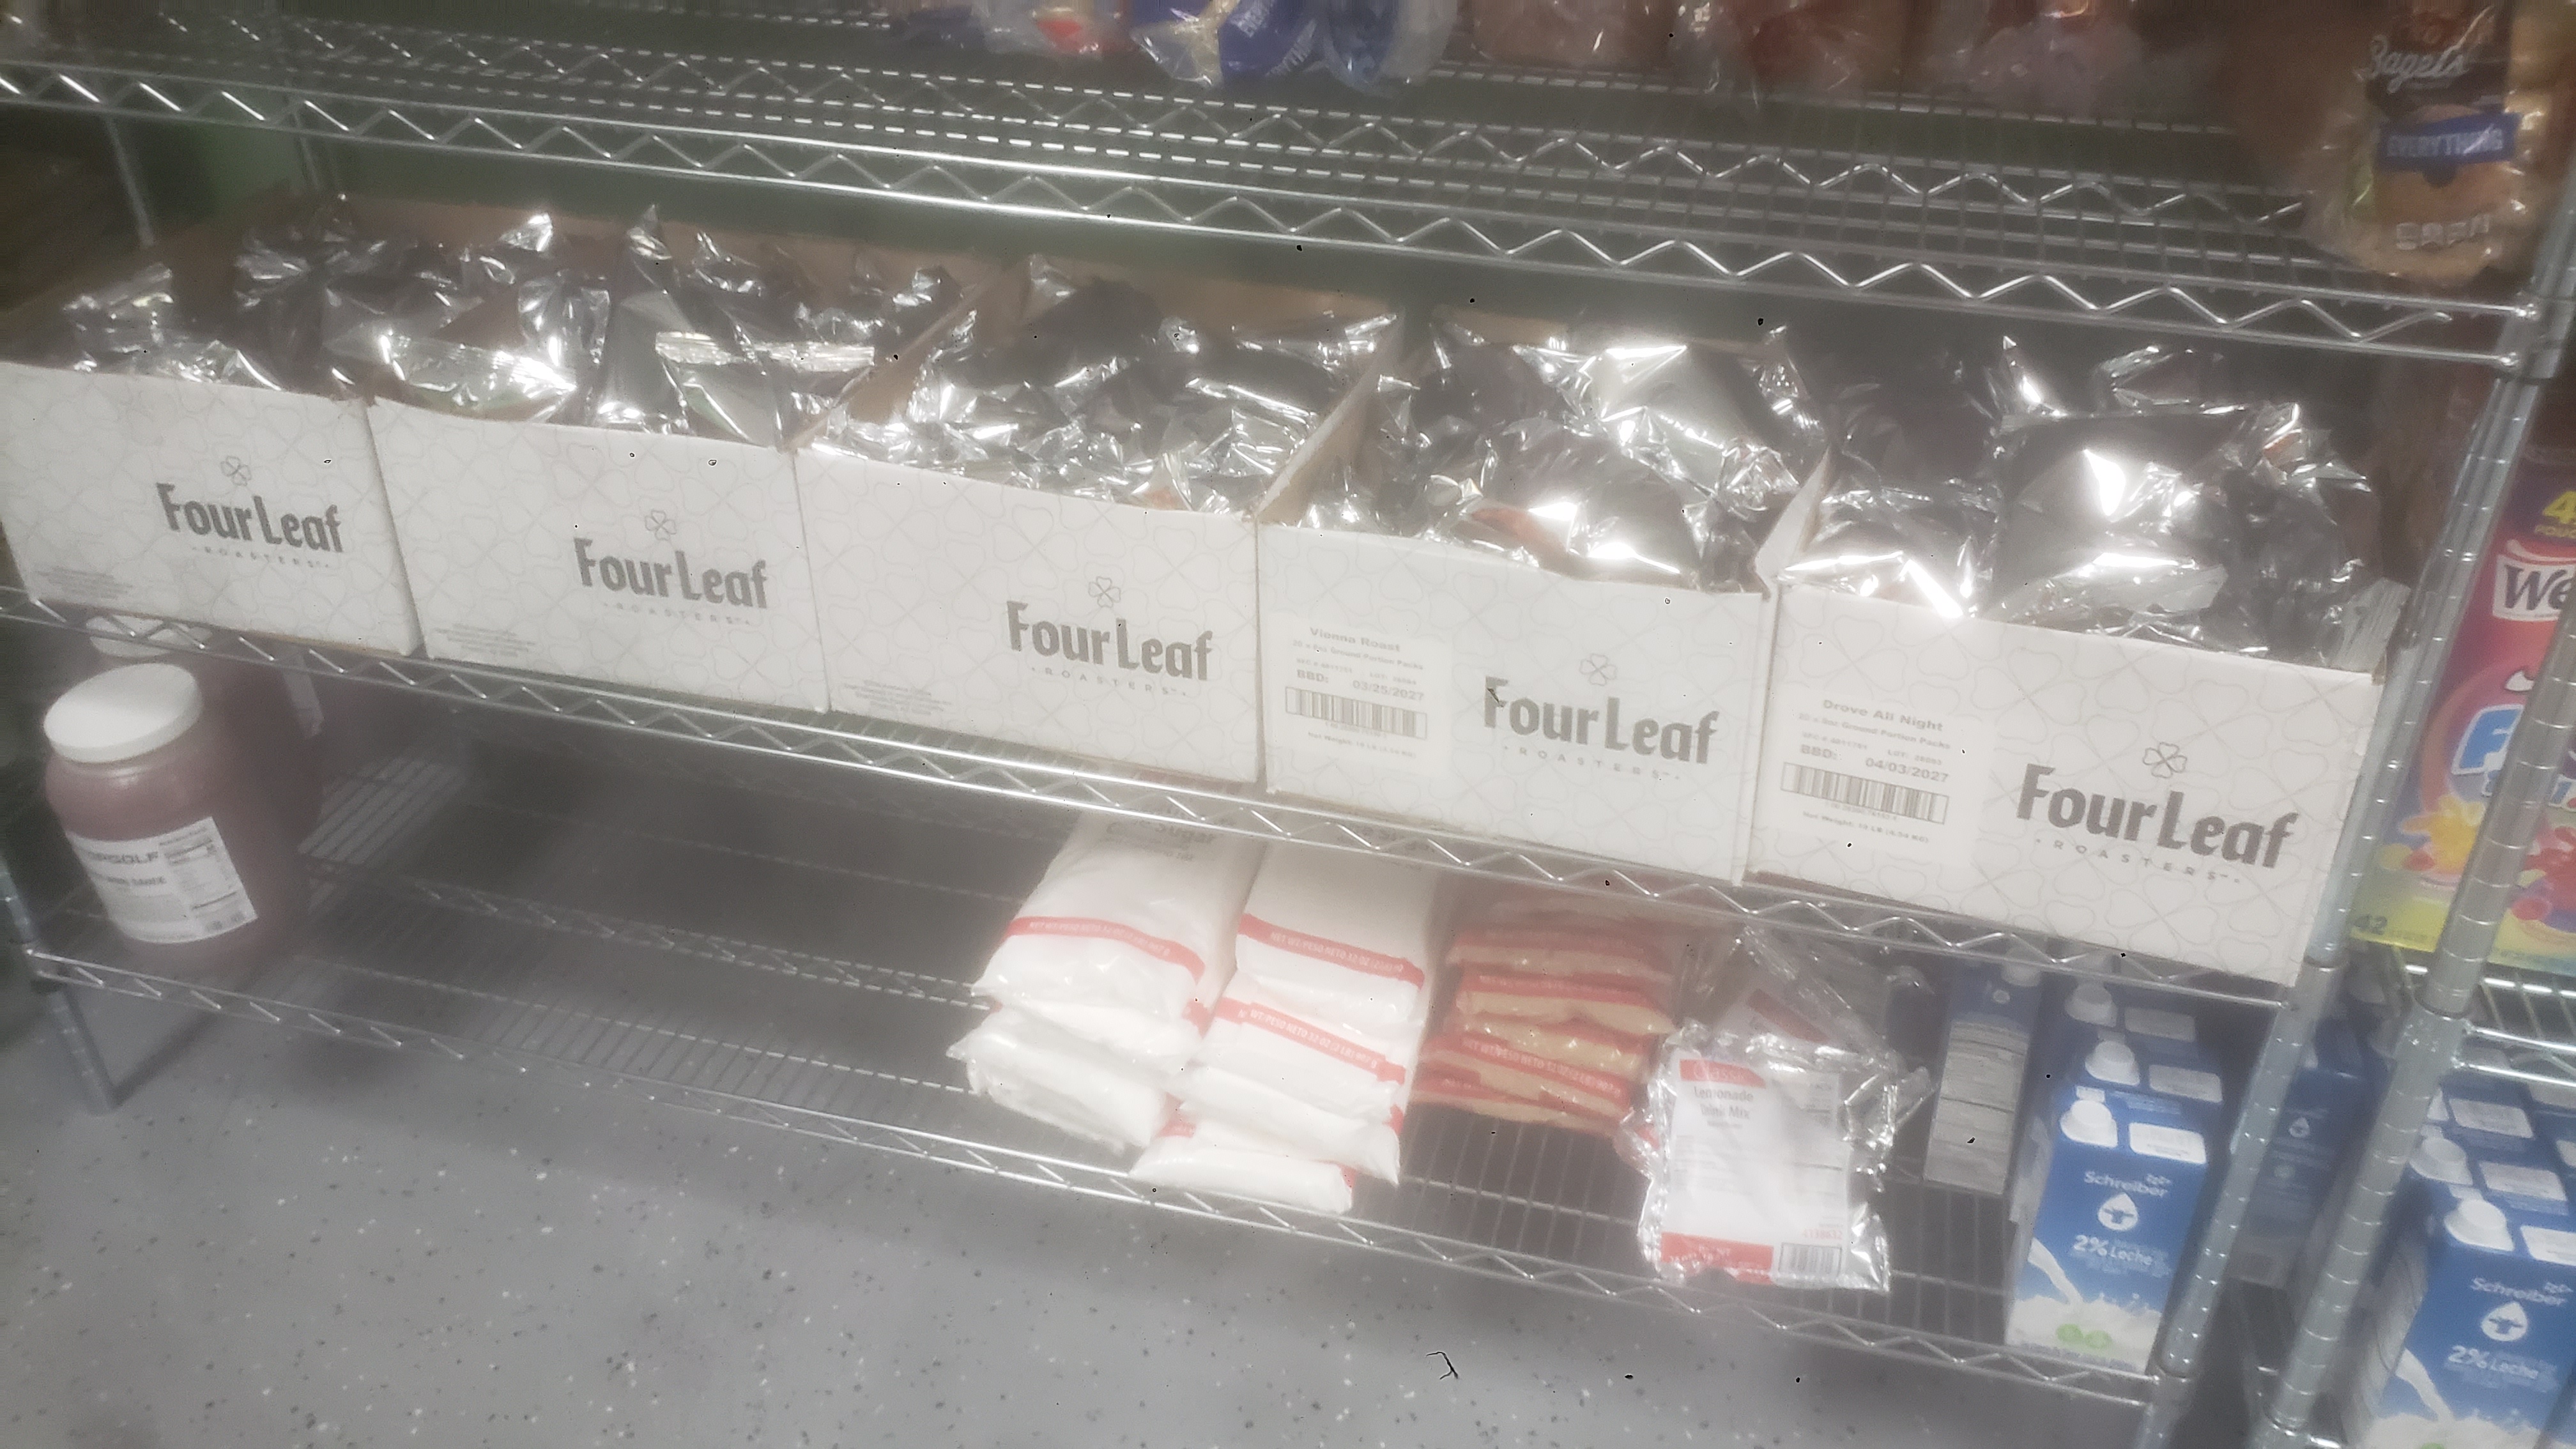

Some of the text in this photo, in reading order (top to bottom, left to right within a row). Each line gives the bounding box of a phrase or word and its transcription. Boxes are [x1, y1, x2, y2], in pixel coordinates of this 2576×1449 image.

[1361, 638, 1400, 652] Roast
[1353, 680, 1425, 701] 03/25/2027
[1823, 700, 1943, 732] Drove All Night
[1866, 758, 1949, 783] 04/03/2027
[1285, 1023, 1308, 1038] NETO
[1318, 1036, 1331, 1048] OZ
[1693, 1085, 1754, 1101] Lemonade
[2083, 1170, 2168, 1198] Schreiber
